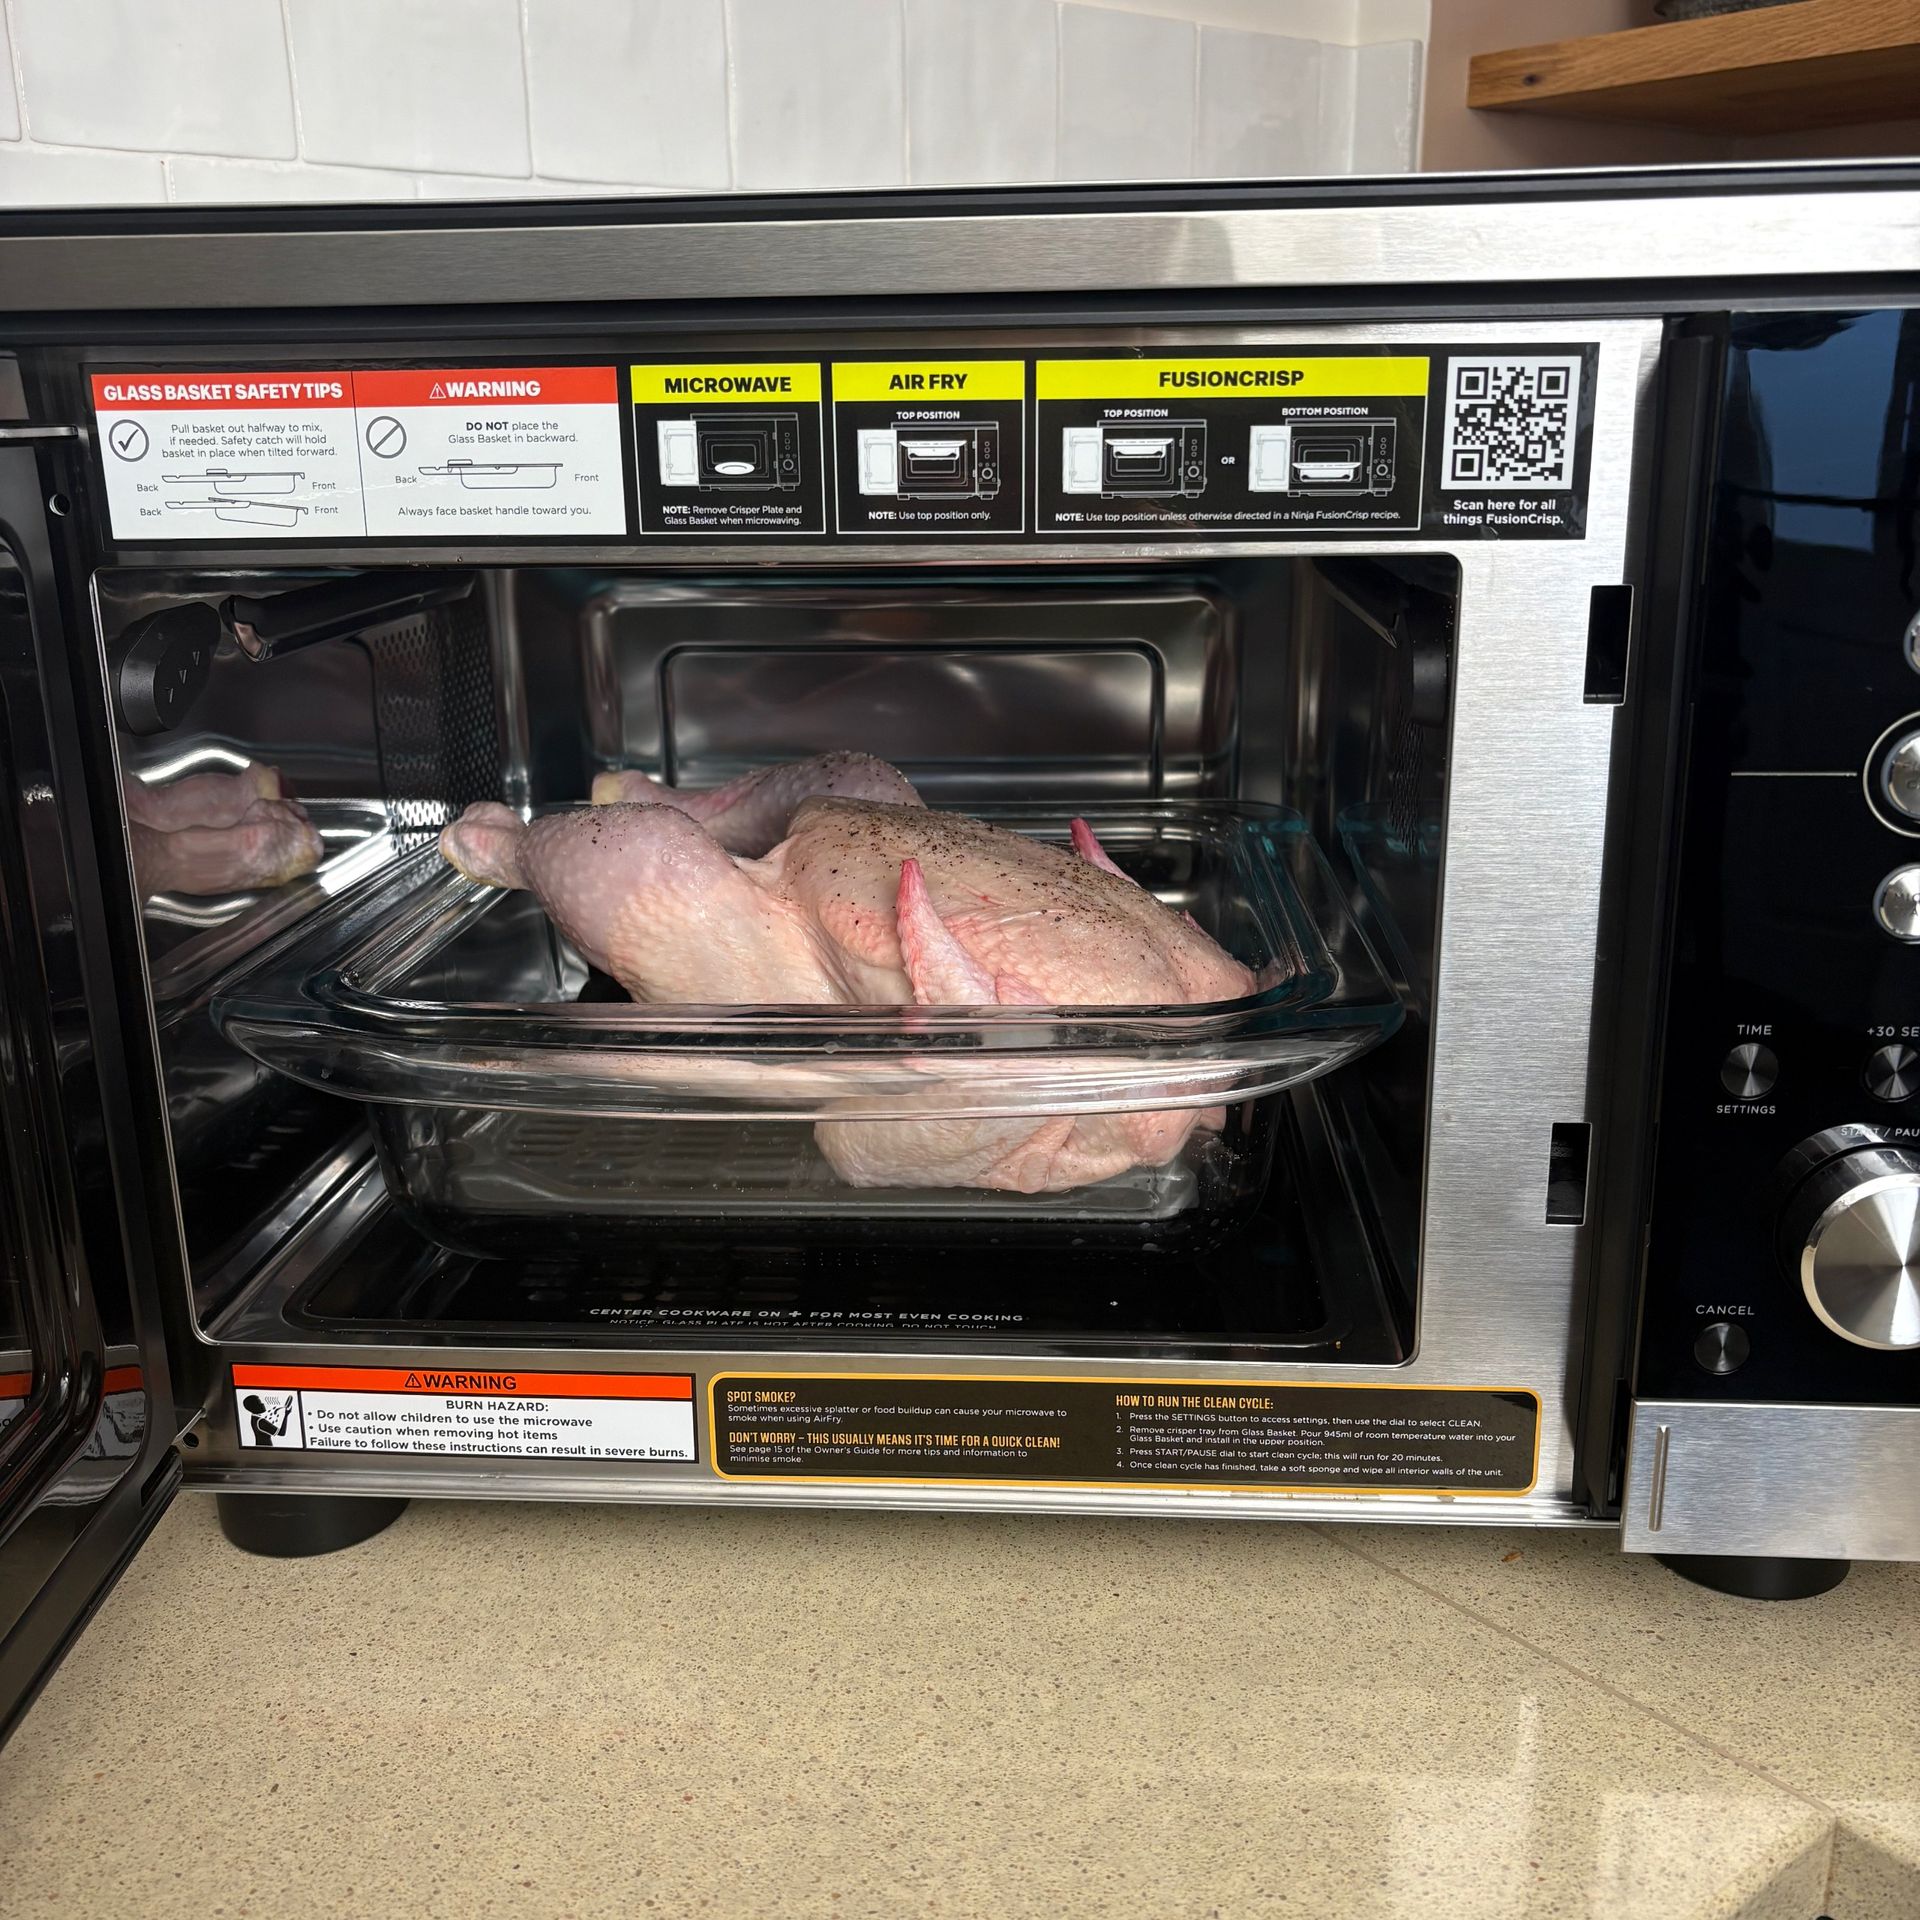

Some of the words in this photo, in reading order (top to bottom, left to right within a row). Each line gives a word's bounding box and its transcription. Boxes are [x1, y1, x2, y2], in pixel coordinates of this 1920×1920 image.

[889, 374, 924, 389] AIR
[929, 374, 967, 389] FRY
[1159, 370, 1303, 386] FUSIONCRISP
[446, 381, 540, 397] WARNING
[664, 377, 791, 392] MICROWAVE
[103, 385, 162, 400] GLASS
[164, 384, 232, 400] BASKET
[235, 383, 301, 399] SAFETY
[303, 382, 342, 398] TIPS
[896, 411, 915, 419] TOP
[916, 411, 959, 419] POSITION
[1103, 409, 1122, 417] TOP
[1124, 409, 1168, 417] POSITION
[1281, 407, 1322, 415] BOTTOM
[1323, 407, 1368, 415] POSITION
[171, 424, 189, 433] Pull
[192, 424, 225, 433] basket
[227, 424, 244, 432] out
[247, 423, 285, 433] halfway
[288, 424, 299, 432] to
[301, 423, 322, 432] mix,
[466, 421, 482, 430] DO
[485, 421, 508, 430] NOT
[512, 422, 538, 430] place
[541, 421, 558, 429] the
[169, 436, 175, 445] if
[178, 436, 218, 445] needed.
[221, 435, 252, 446] Safety
[255, 435, 283, 444] catch
[285, 435, 302, 444] will
[304, 434, 326, 444] hold
[448, 434, 474, 443] Glass
[477, 434, 511, 443] Basket
[514, 433, 523, 442] in
[526, 433, 577, 442] backward.
[161, 449, 194, 457] basket
[197, 449, 206, 457] in
[209, 448, 235, 458] place
[237, 448, 265, 456] when
[267, 447, 293, 456] tilted
[296, 446, 337, 456] forward.
[1221, 456, 1235, 464] OR
[395, 475, 417, 483] Back
[574, 473, 598, 481] Front
[136, 483, 158, 491] Back
[311, 481, 336, 489] Front
[314, 505, 338, 513] Front
[662, 505, 690, 514] NOTE:
[692, 505, 727, 513] Remove
[729, 505, 760, 514] Crisper
[762, 505, 783, 513] Plate
[785, 505, 802, 513] and
[1453, 499, 1483, 510] Scan
[1487, 499, 1515, 510] here
[1519, 499, 1537, 509] for
[1540, 499, 1556, 510] all
[139, 508, 161, 516] Back
[398, 507, 433, 517] Always
[435, 506, 457, 515] face
[459, 506, 492, 515] basket
[495, 505, 529, 514] handle
[532, 505, 567, 514] toward
[570, 507, 591, 516] you.
[868, 511, 896, 519] NOTE:
[898, 511, 915, 519] Use
[917, 511, 932, 520] top
[934, 511, 968, 520] position
[970, 511, 990, 520] only.
[1055, 512, 1084, 521] NOTE:
[1086, 513, 1102, 521] Use
[1104, 513, 1120, 521] top
[1121, 512, 1157, 521] position
[1159, 512, 1187, 520] unless
[1188, 512, 1232, 520] otherwise
[1234, 511, 1271, 520] directed
[1273, 511, 1281, 519] in
[1291, 511, 1314, 520] Ninja
[1315, 510, 1369, 519] FusionCrisp
[1370, 511, 1400, 519] recipe.
[664, 516, 687, 524] Glass
[688, 516, 717, 524] Basket
[719, 516, 743, 524] when
[745, 516, 801, 525] microwaving.
[1443, 513, 1482, 525] things
[1486, 513, 1563, 525] FusionCrisp.
[1737, 1024, 1771, 1035] TIME
[1867, 1026, 1895, 1036] +30
[1716, 1104, 1775, 1114] SETTINGS
[1841, 1127, 1880, 1136] STAT
[1695, 1304, 1754, 1315] CANCEL
[423, 1374, 516, 1389] WARNING
[727, 1391, 752, 1402] SPOT
[754, 1391, 795, 1402] SMOKE?
[1116, 1395, 1139, 1406] HOW
[1142, 1395, 1154, 1406] TO
[1157, 1395, 1179, 1407] RUN
[1181, 1396, 1200, 1407] THE
[1203, 1396, 1235, 1408] CLEAN
[1239, 1397, 1273, 1409] CYCLE:
[446, 1400, 482, 1409] BURN
[487, 1401, 548, 1411] HAZARD:
[317, 1409, 334, 1419] Do
[338, 1411, 359, 1420] not
[363, 1411, 396, 1421] allow
[400, 1412, 451, 1423] children
[455, 1414, 469, 1423] to
[473, 1416, 494, 1424] use
[498, 1415, 519, 1425] the
[523, 1416, 592, 1426] microwave
[786, 1414, 810, 1423] using
[813, 1415, 844, 1425] AirFry.
[729, 1432, 757, 1442] DON'T
[760, 1432, 795, 1443] WORRY
[807, 1433, 829, 1443] THIS
[832, 1433, 873, 1444] USUALLY
[876, 1434, 911, 1445] MEANS
[914, 1434, 932, 1445] IT'S
[934, 1434, 958, 1445] TIME
[961, 1435, 980, 1446] FOR
[982, 1435, 989, 1446] A
[991, 1435, 1022, 1447] QUICK
[1025, 1436, 1059, 1447] CLEAN!
[1130, 1447, 1152, 1455] Press
[1155, 1448, 1216, 1456] START/PAUSE
[1391, 1453, 1403, 1461] 20
